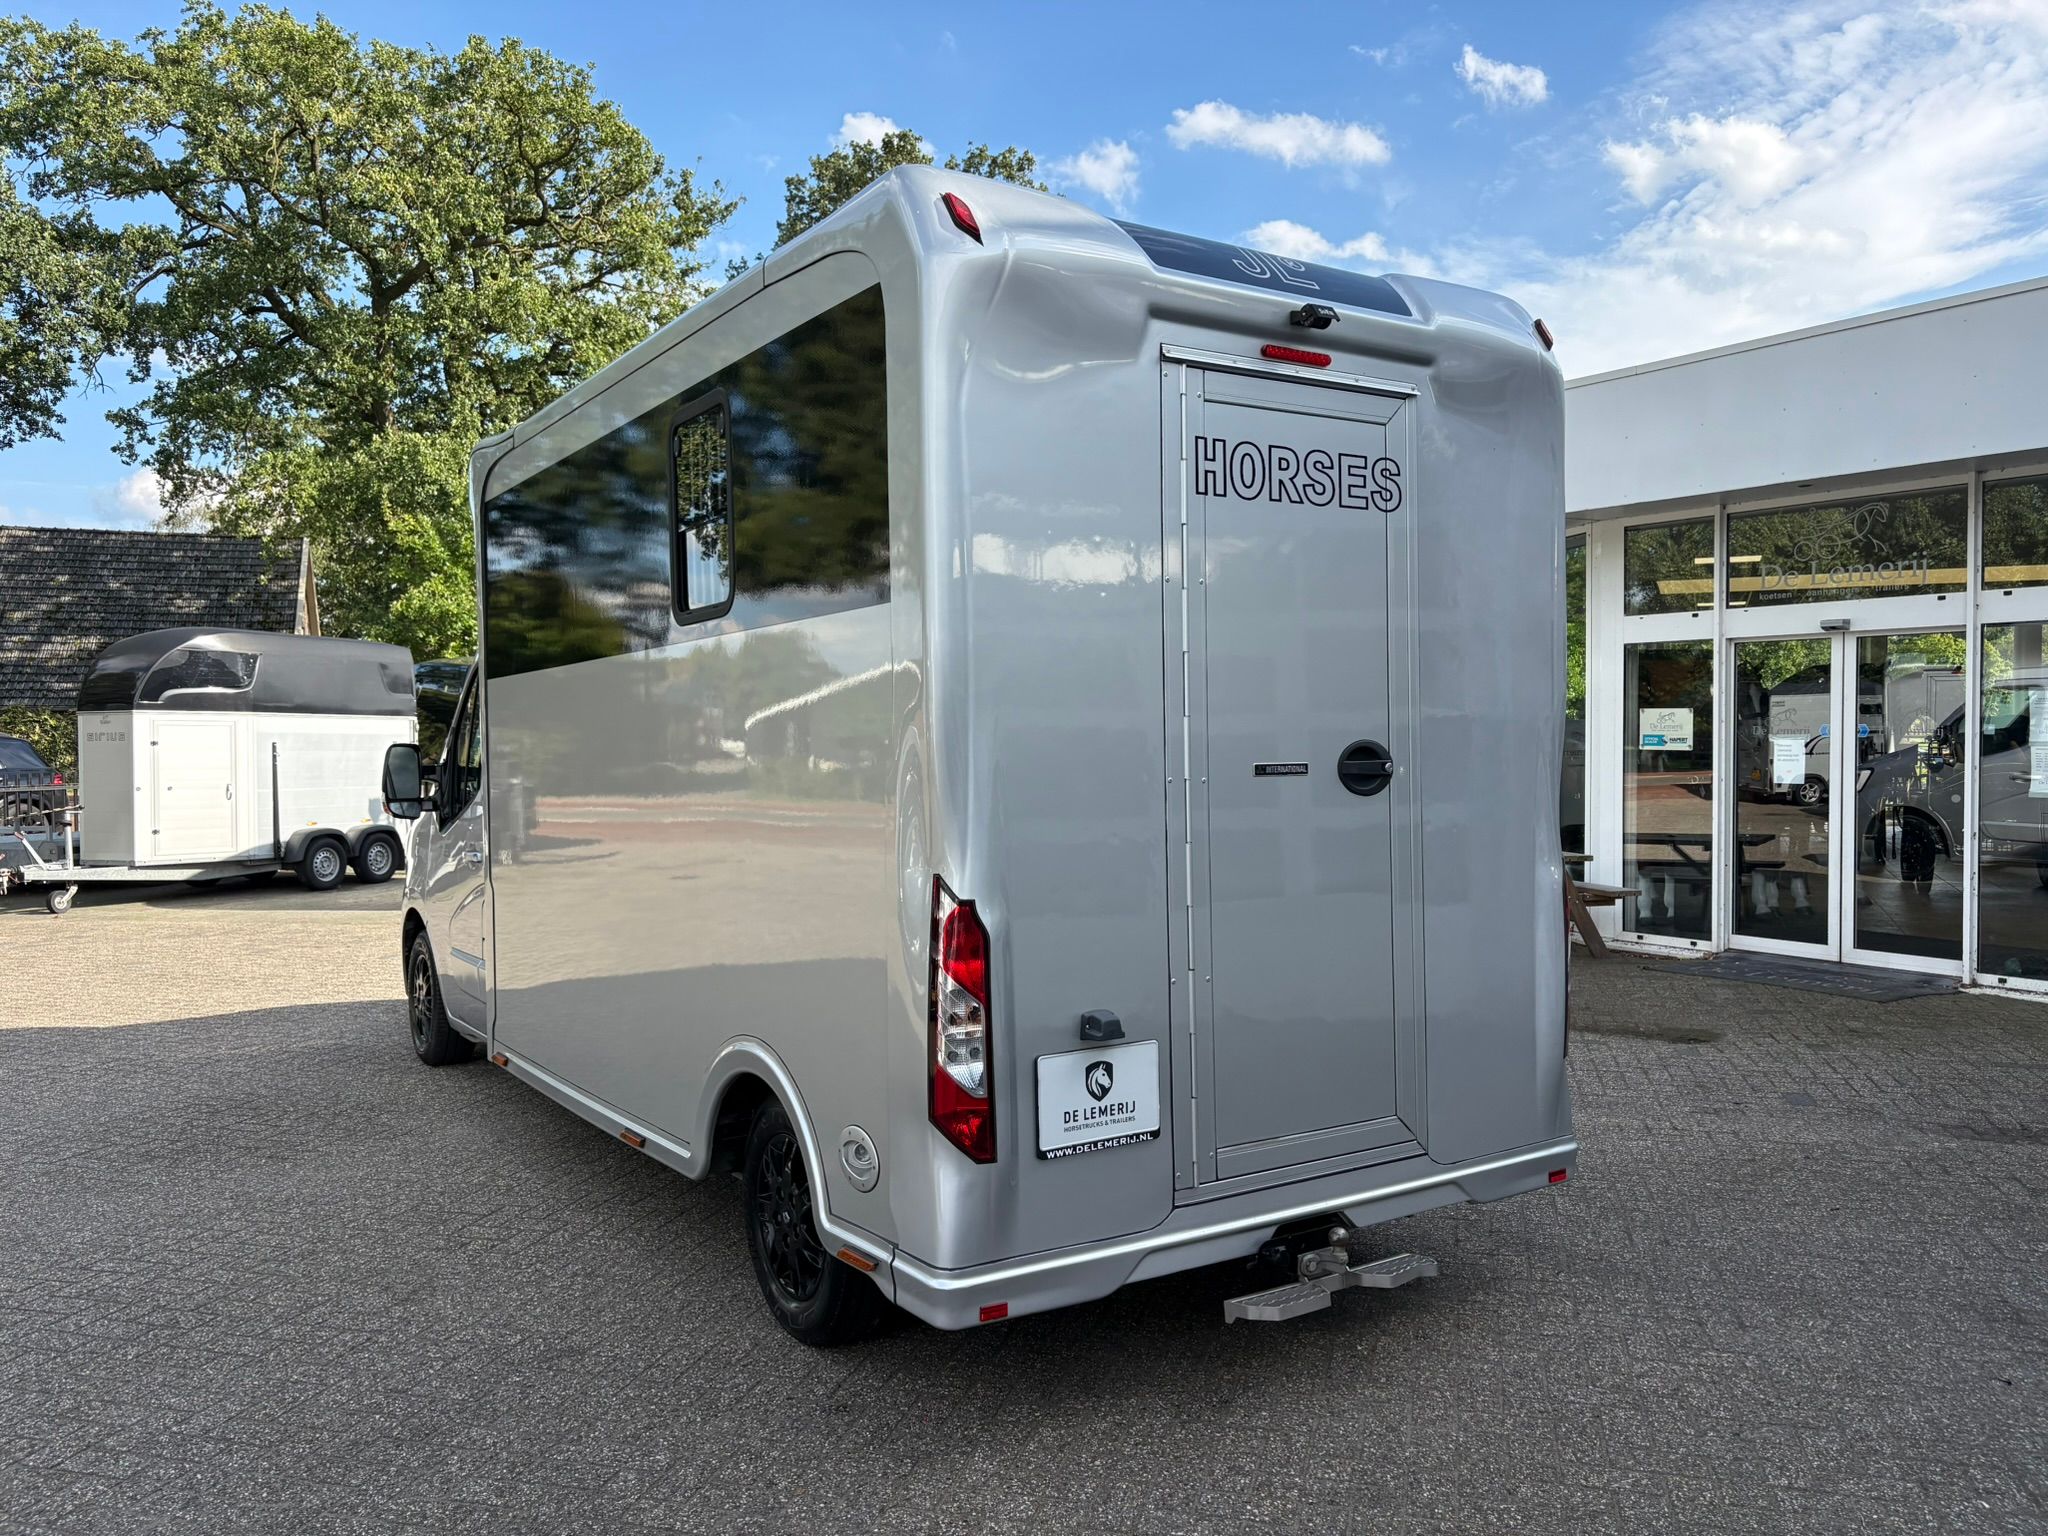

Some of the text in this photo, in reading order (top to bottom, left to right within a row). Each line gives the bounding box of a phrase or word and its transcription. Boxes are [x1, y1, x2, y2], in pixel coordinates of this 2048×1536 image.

[1195, 435, 1402, 513] HORSES
[1759, 551, 1929, 590] De Lemerij
[1759, 591, 1792, 600] koetsen
[1063, 1100, 1136, 1124] DE LEMERIJ
[1063, 1121, 1103, 1133] HORSETRUCKS
[1110, 1115, 1136, 1125] TRAILERS
[1046, 1132, 1154, 1159] WWW.DELEMERIJ.NL
